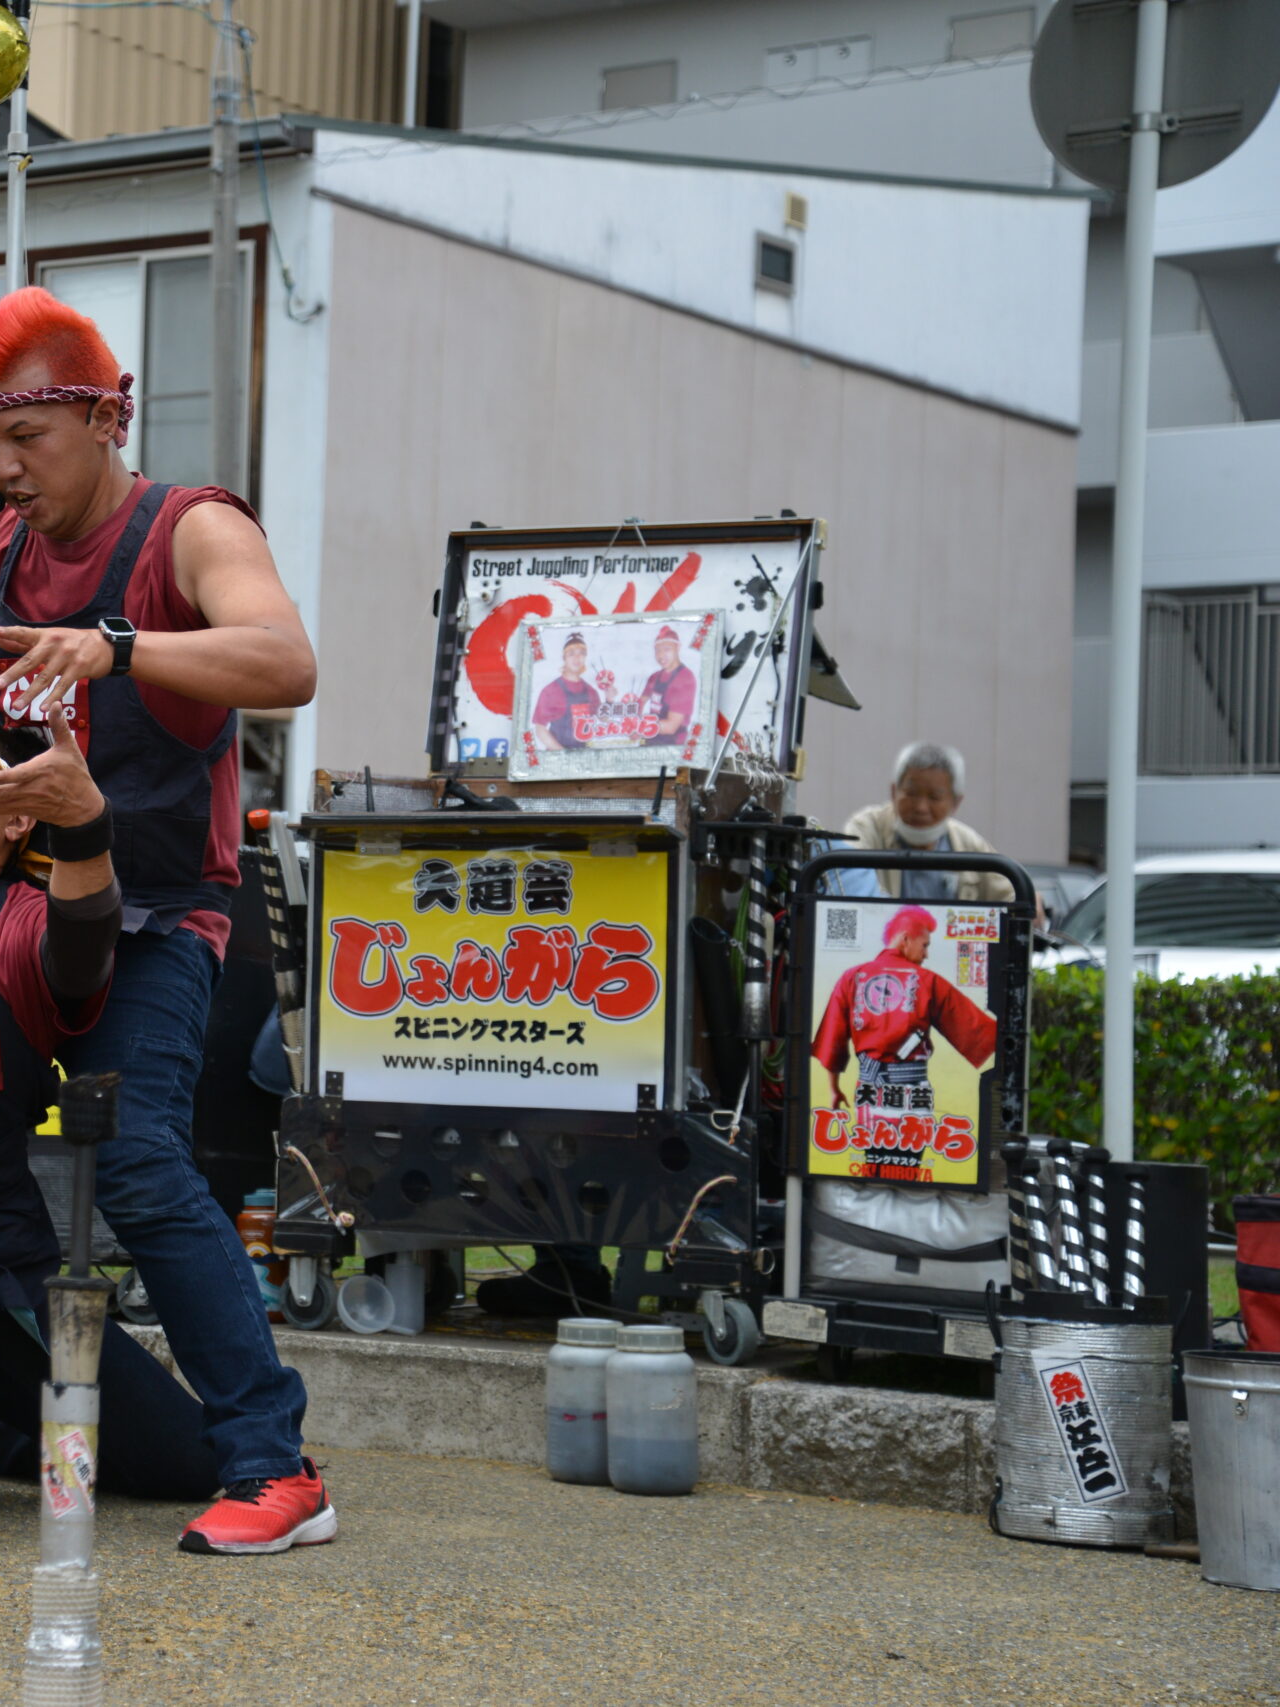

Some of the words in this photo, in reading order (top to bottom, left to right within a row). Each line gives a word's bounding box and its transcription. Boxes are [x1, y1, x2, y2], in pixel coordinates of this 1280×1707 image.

[472, 558, 522, 577] Street
[527, 556, 590, 578] Juggling
[593, 554, 679, 575] Performer
[574, 714, 660, 742] じょんがら
[413, 858, 573, 915] 大道芸
[329, 916, 660, 1021] じょんがら
[394, 1016, 586, 1045] スピニングマスターズ
[383, 1054, 599, 1079] www.spinning4.com
[856, 1083, 934, 1110] 大道芸
[812, 1106, 977, 1162] じょんがら
[849, 1152, 935, 1168] ニングマスター
[1049, 1371, 1086, 1407] 祭
